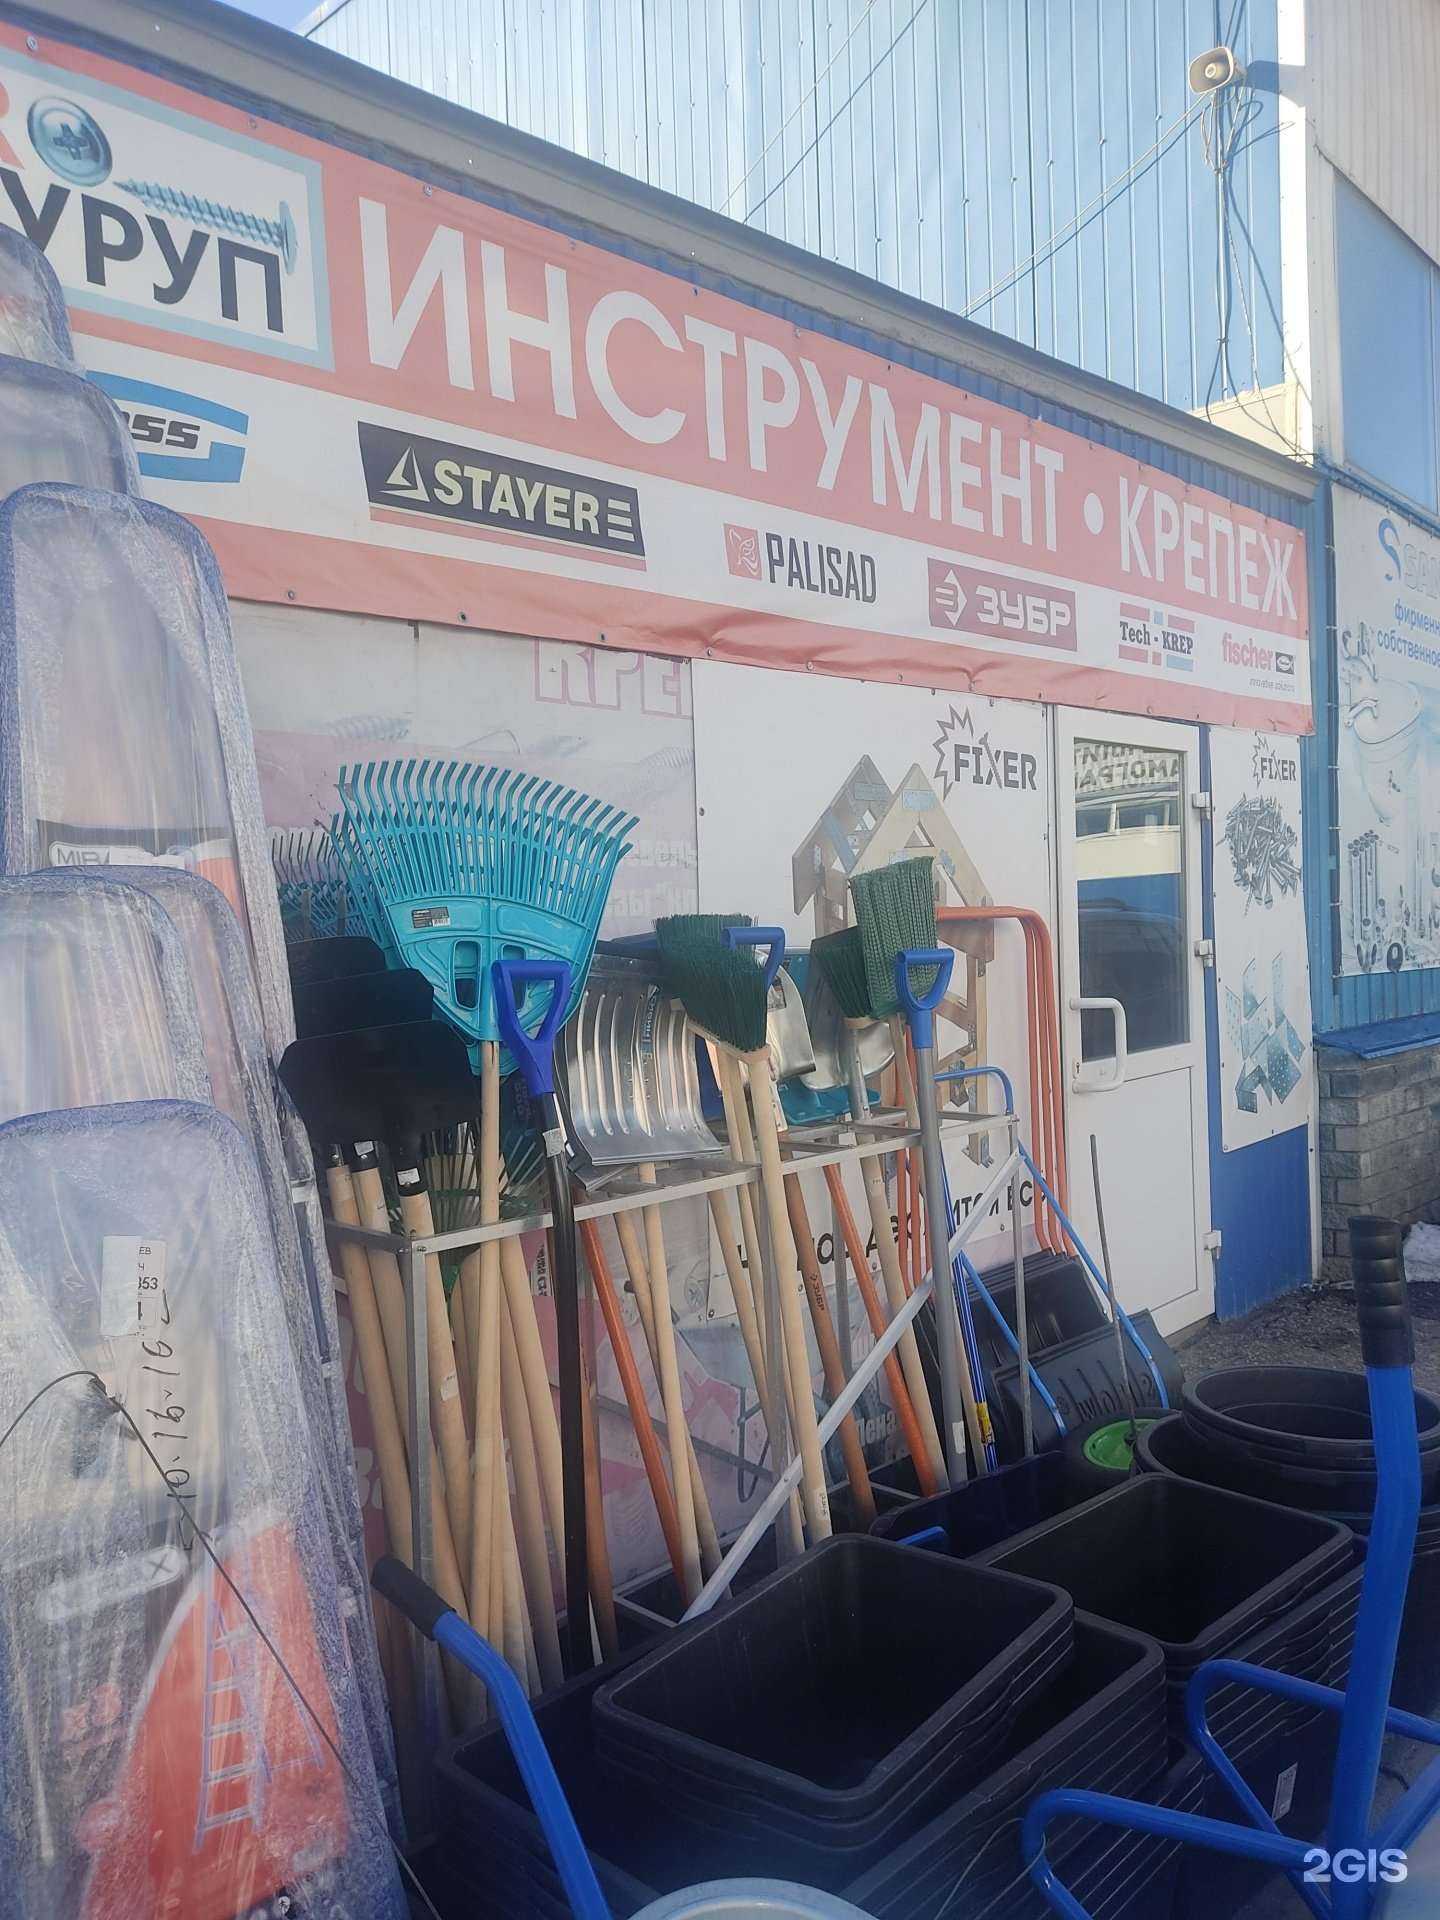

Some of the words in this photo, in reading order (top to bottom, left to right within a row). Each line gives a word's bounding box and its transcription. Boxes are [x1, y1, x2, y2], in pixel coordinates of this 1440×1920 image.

[122, 410, 201, 450] SS
[358, 196, 1064, 552] ИНСТРУМЕНТ
[1119, 476, 1298, 621] КРЕПЕЖ
[432, 459, 600, 535] STAYER
[765, 532, 878, 604] PALISAD
[975, 585, 1072, 636] ЗУБР
[1119, 620, 1151, 646] Tech
[1161, 630, 1194, 655] KREP
[1222, 631, 1274, 671] fischer
[954, 738, 1037, 791] FIXER
[1260, 753, 1297, 782] FIXER
